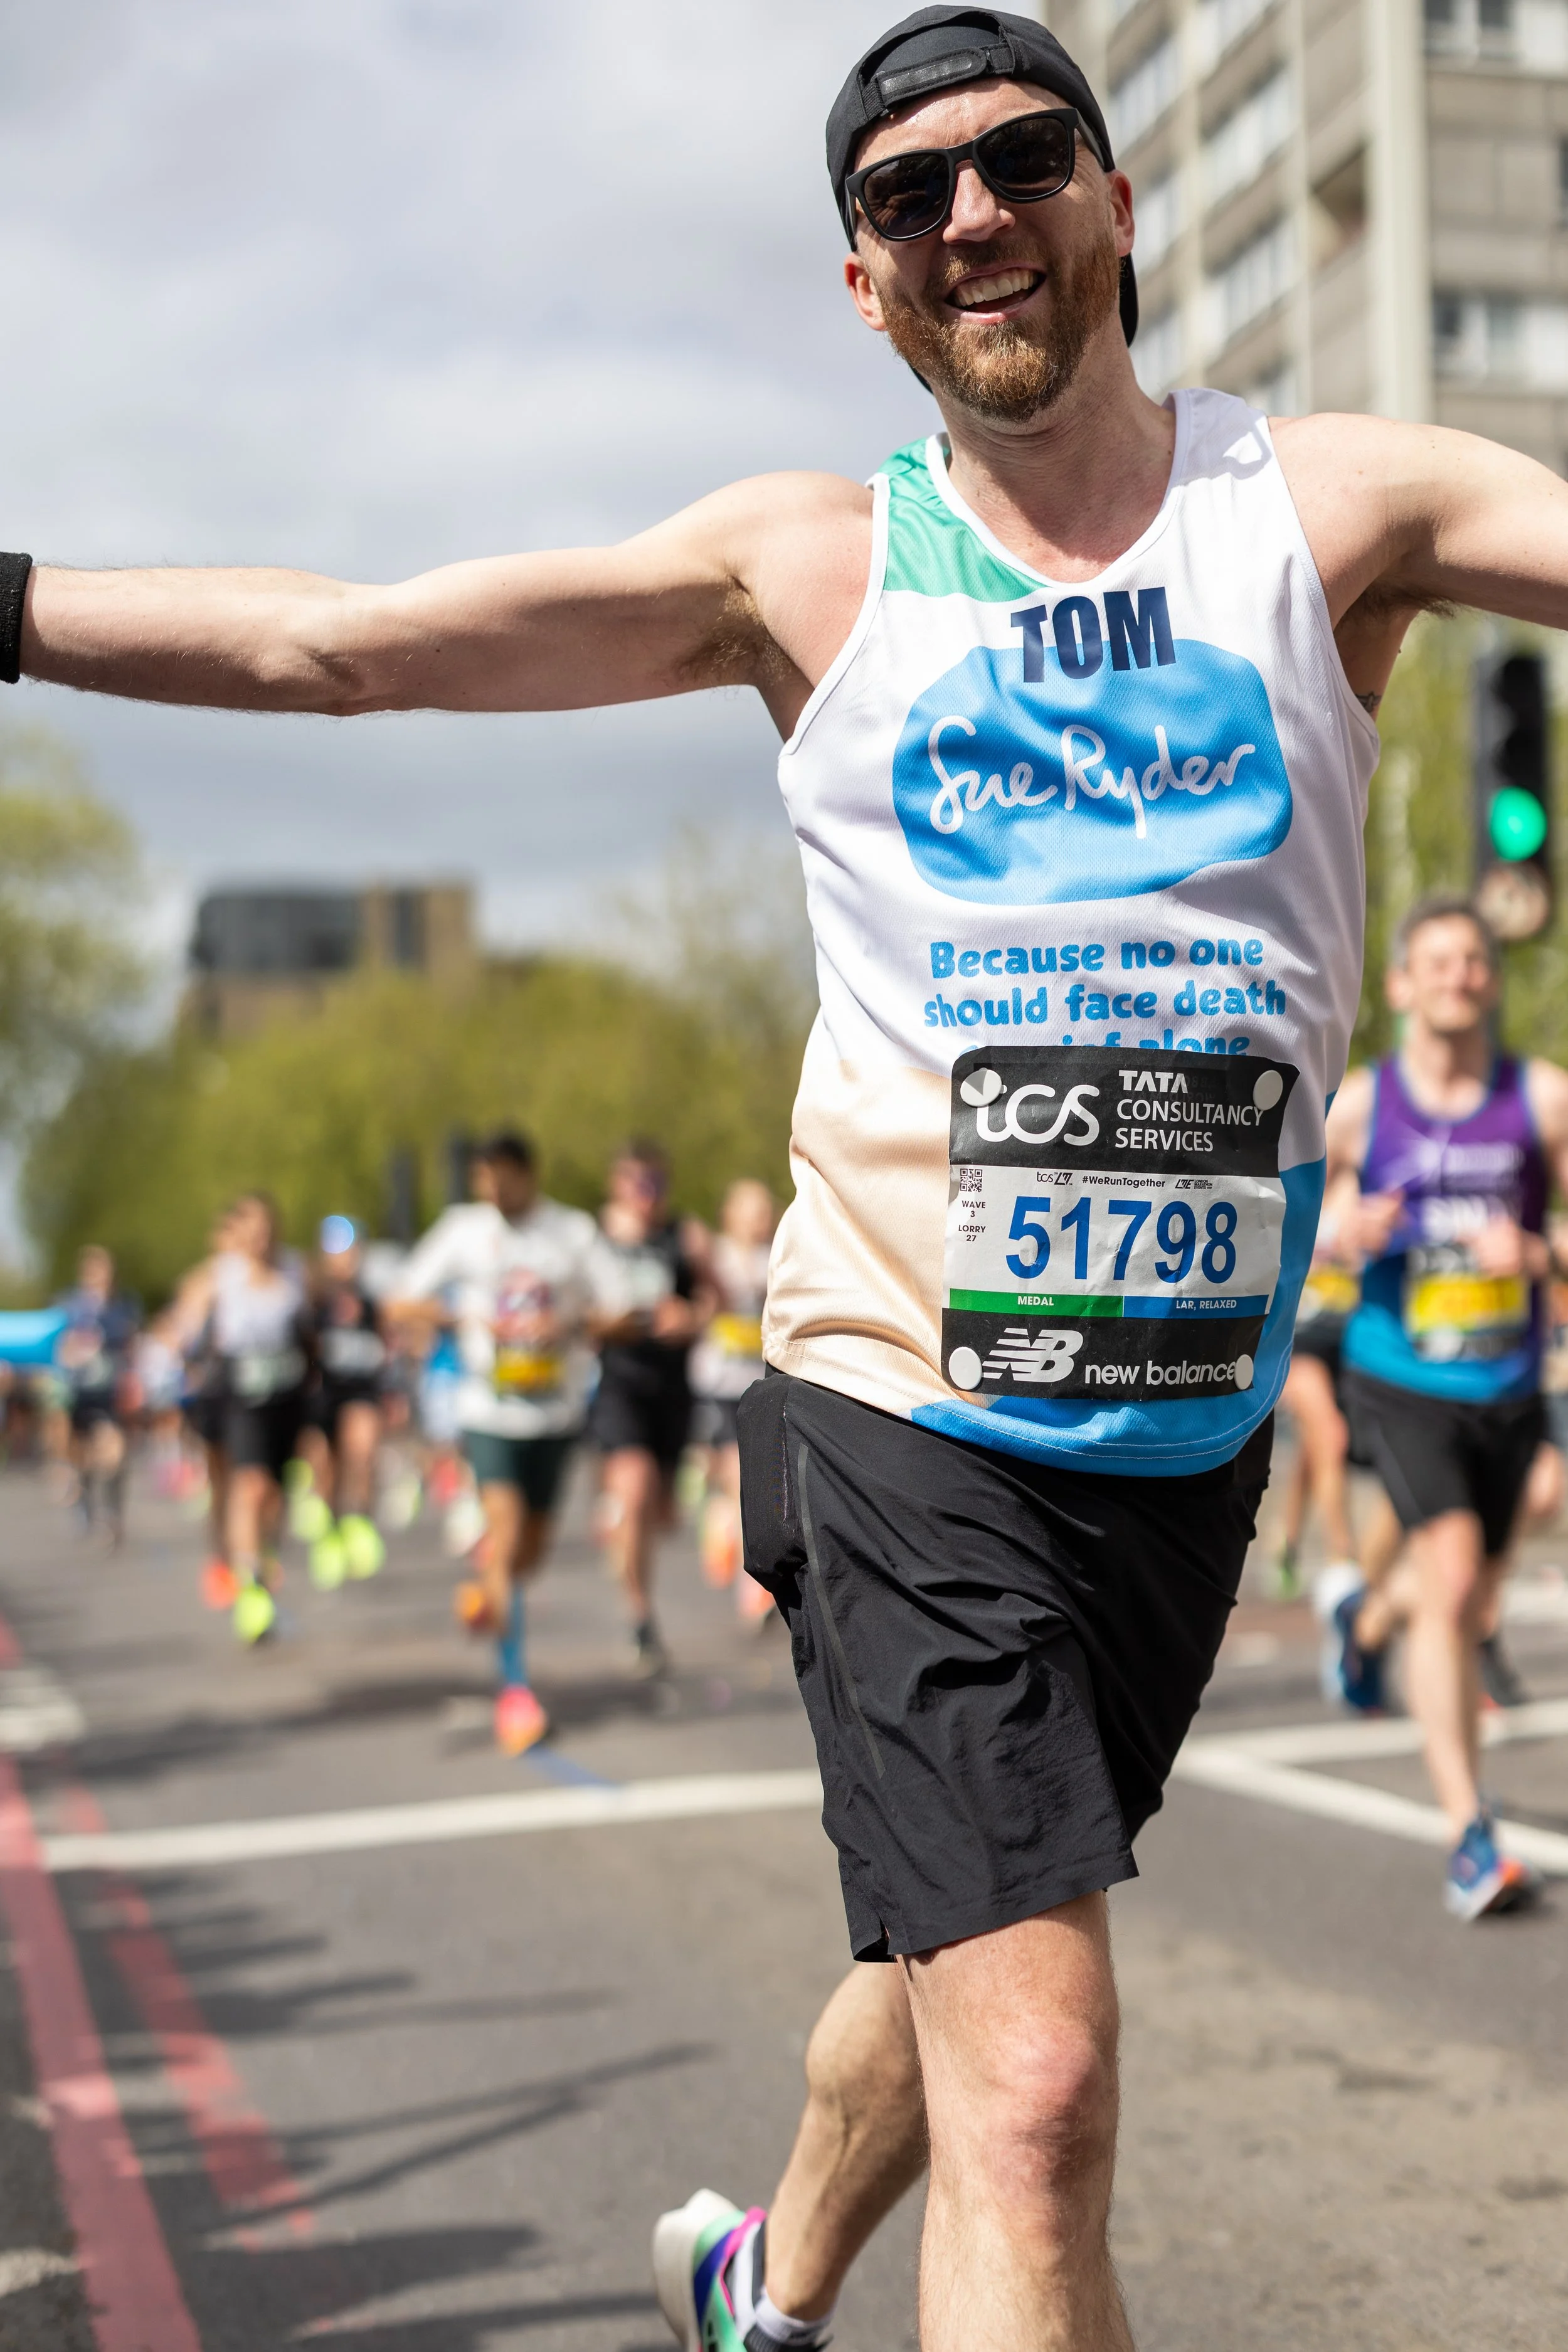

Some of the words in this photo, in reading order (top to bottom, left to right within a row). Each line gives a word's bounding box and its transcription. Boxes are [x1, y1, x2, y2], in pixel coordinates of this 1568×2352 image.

[1010, 587, 1176, 682] TOM
[928, 715, 1058, 834] Sue
[1061, 724, 1255, 839] Ryder
[930, 941, 1105, 980] Because
[1121, 940, 1175, 970] no
[1189, 938, 1263, 967] one
[924, 986, 1048, 1027] should
[1064, 983, 1158, 1022] face
[1173, 980, 1286, 1017] death
[1119, 1070, 1189, 1094] TATA
[1117, 1099, 1263, 1127] CONSULTANCY
[1115, 1128, 1214, 1152] SERVICES
[1082, 1175, 1166, 1188] #WeRunTogether
[961, 1200, 986, 1209] WAVE
[958, 1224, 986, 1233] LORRY
[1005, 1195, 1237, 1284] 51798
[1017, 1295, 1054, 1306] MEDAL
[1176, 1300, 1196, 1311] LAR,
[1199, 1300, 1237, 1309] RELAXED
[1085, 1364, 1140, 1385] new
[1147, 1360, 1236, 1385] balance
